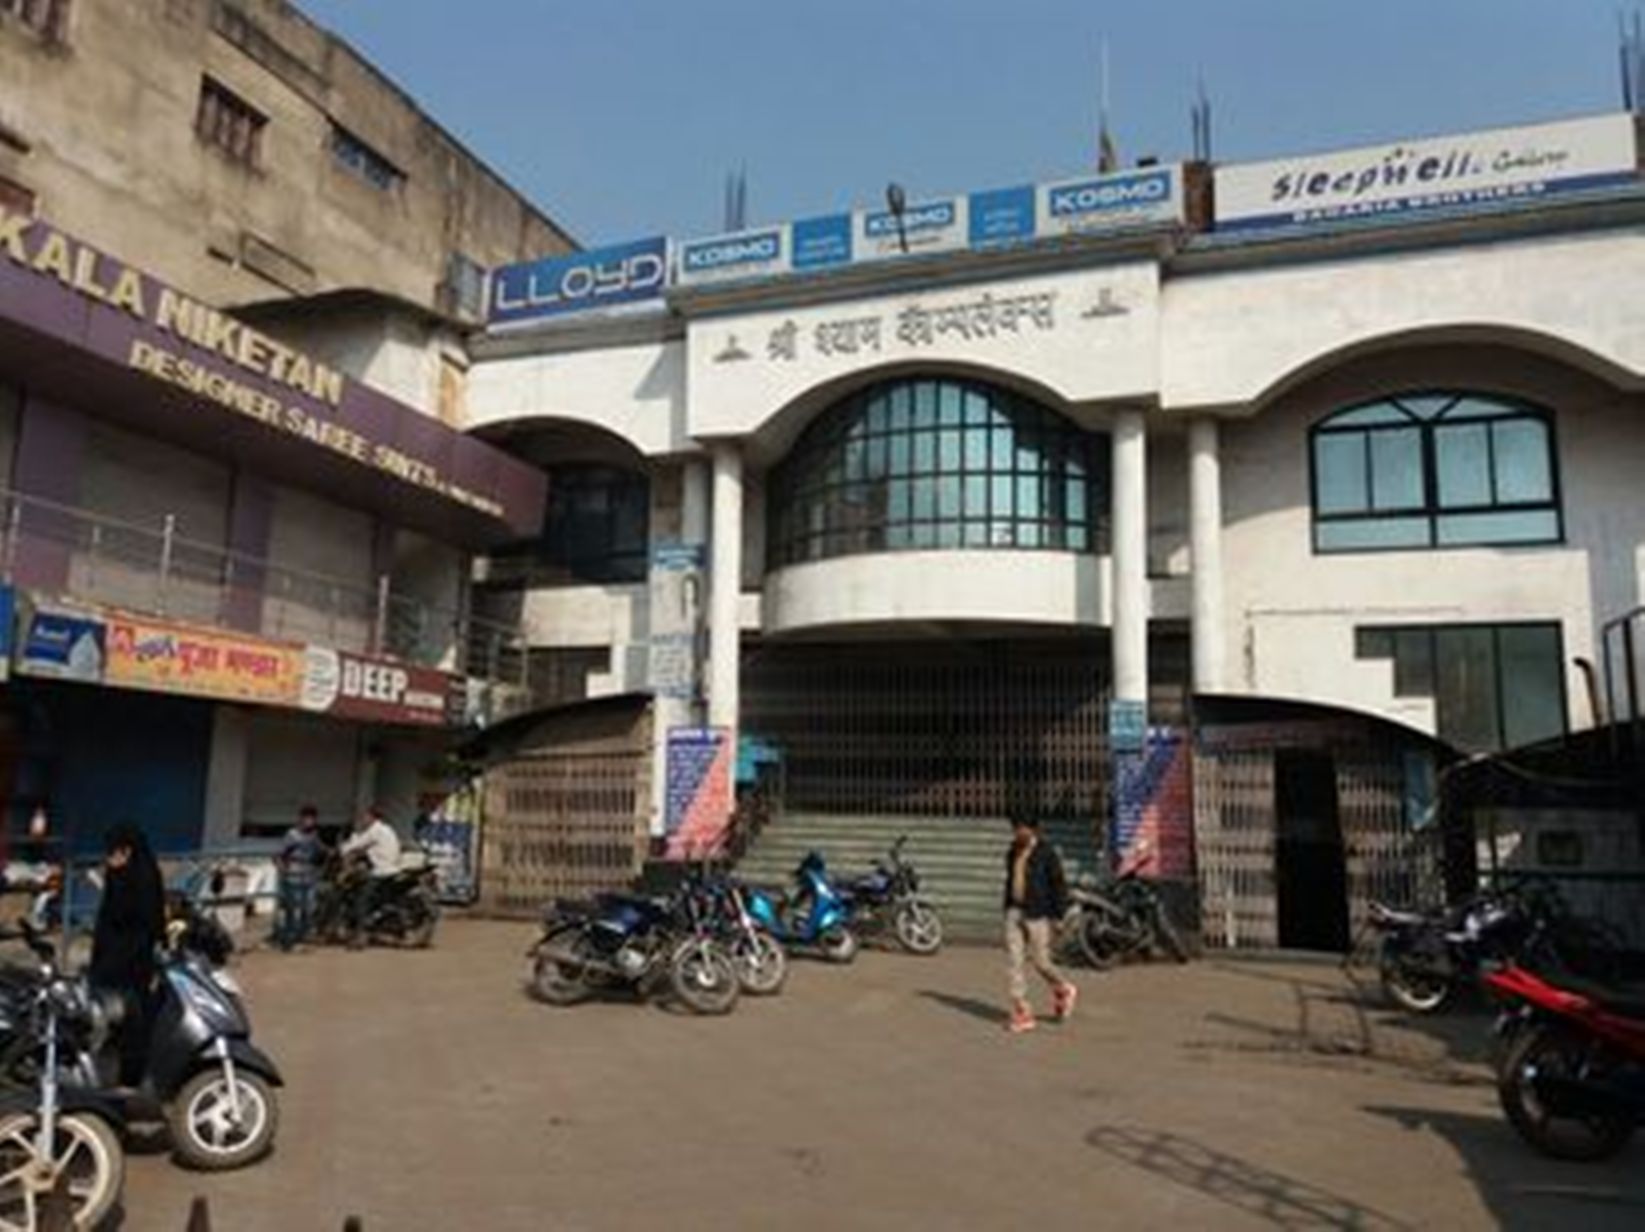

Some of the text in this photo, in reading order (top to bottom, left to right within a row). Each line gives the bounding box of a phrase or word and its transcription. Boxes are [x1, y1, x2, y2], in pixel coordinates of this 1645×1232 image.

[867, 203, 952, 231] KOSMO
[1052, 178, 1167, 213] KOSMO
[688, 239, 777, 265] KOSMO
[497, 254, 662, 309] LLOYD
[0, 215, 341, 406] KALA NIKETAN
[129, 340, 281, 426] DESIGNER
[284, 406, 368, 462] SAREE
[342, 658, 408, 704] DEEP
